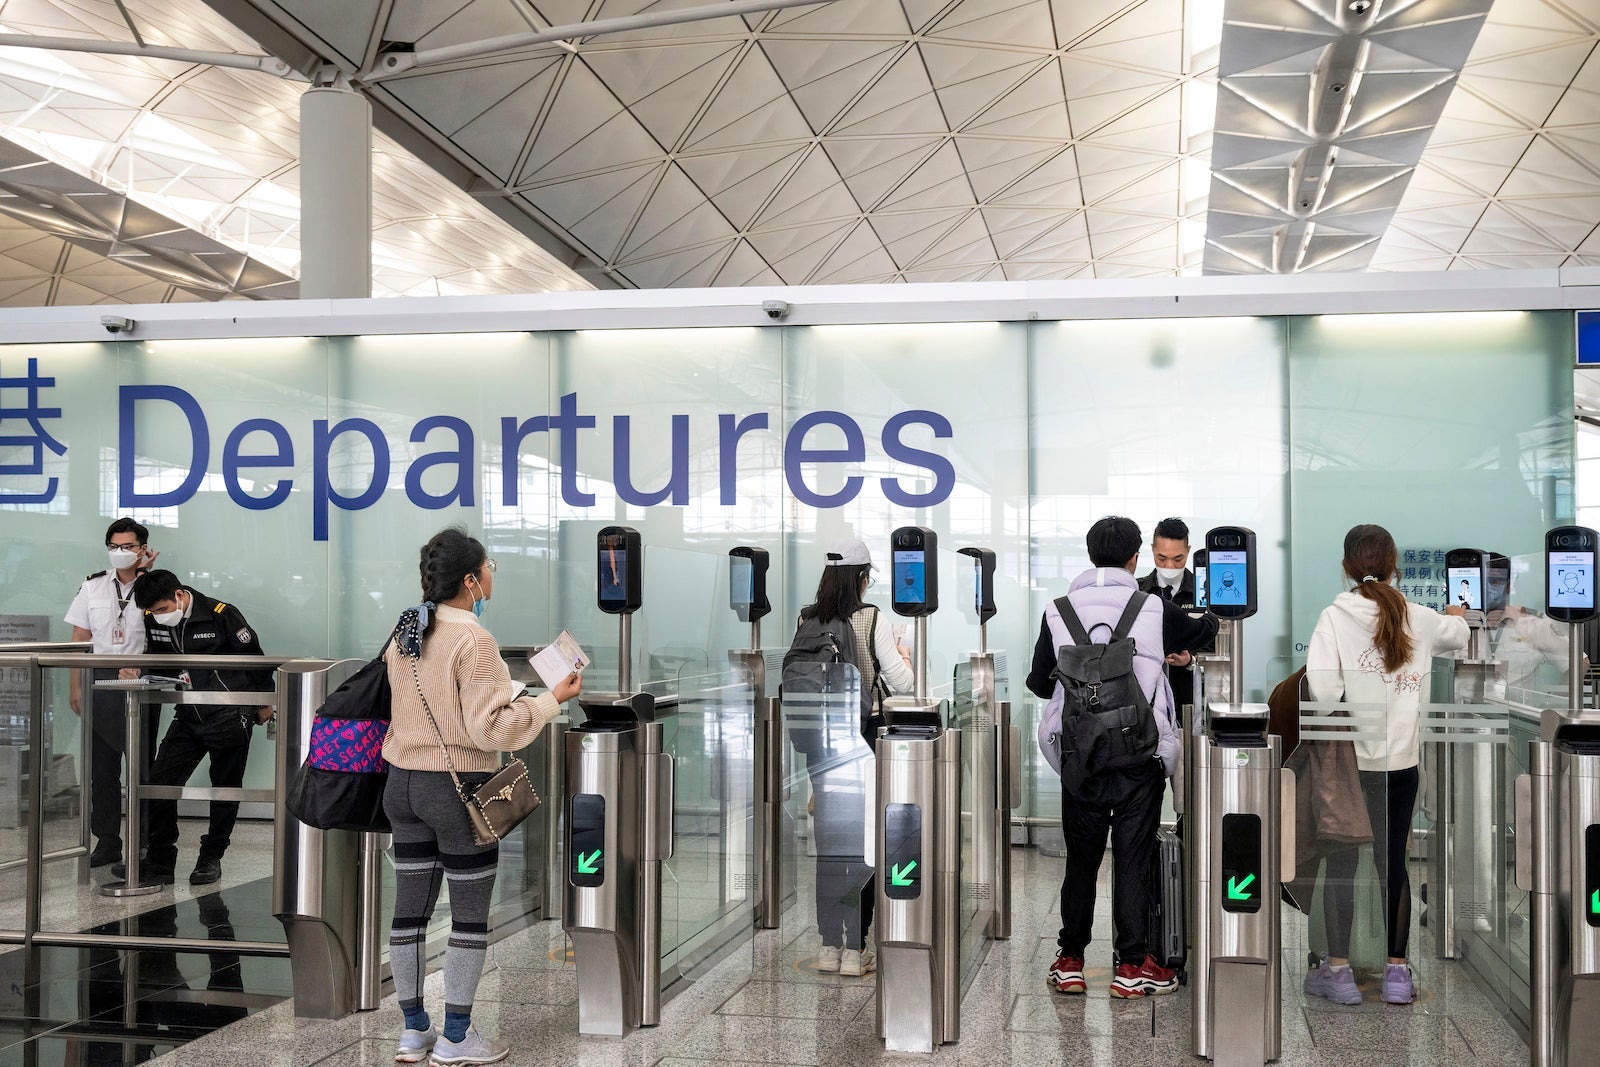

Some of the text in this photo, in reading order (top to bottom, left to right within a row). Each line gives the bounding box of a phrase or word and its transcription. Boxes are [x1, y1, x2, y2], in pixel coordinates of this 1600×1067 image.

[119, 384, 956, 542] Departures
[1393, 567, 1432, 579] 規例
[192, 632, 216, 640] AVSECO
[339, 726, 380, 763] SECRET
